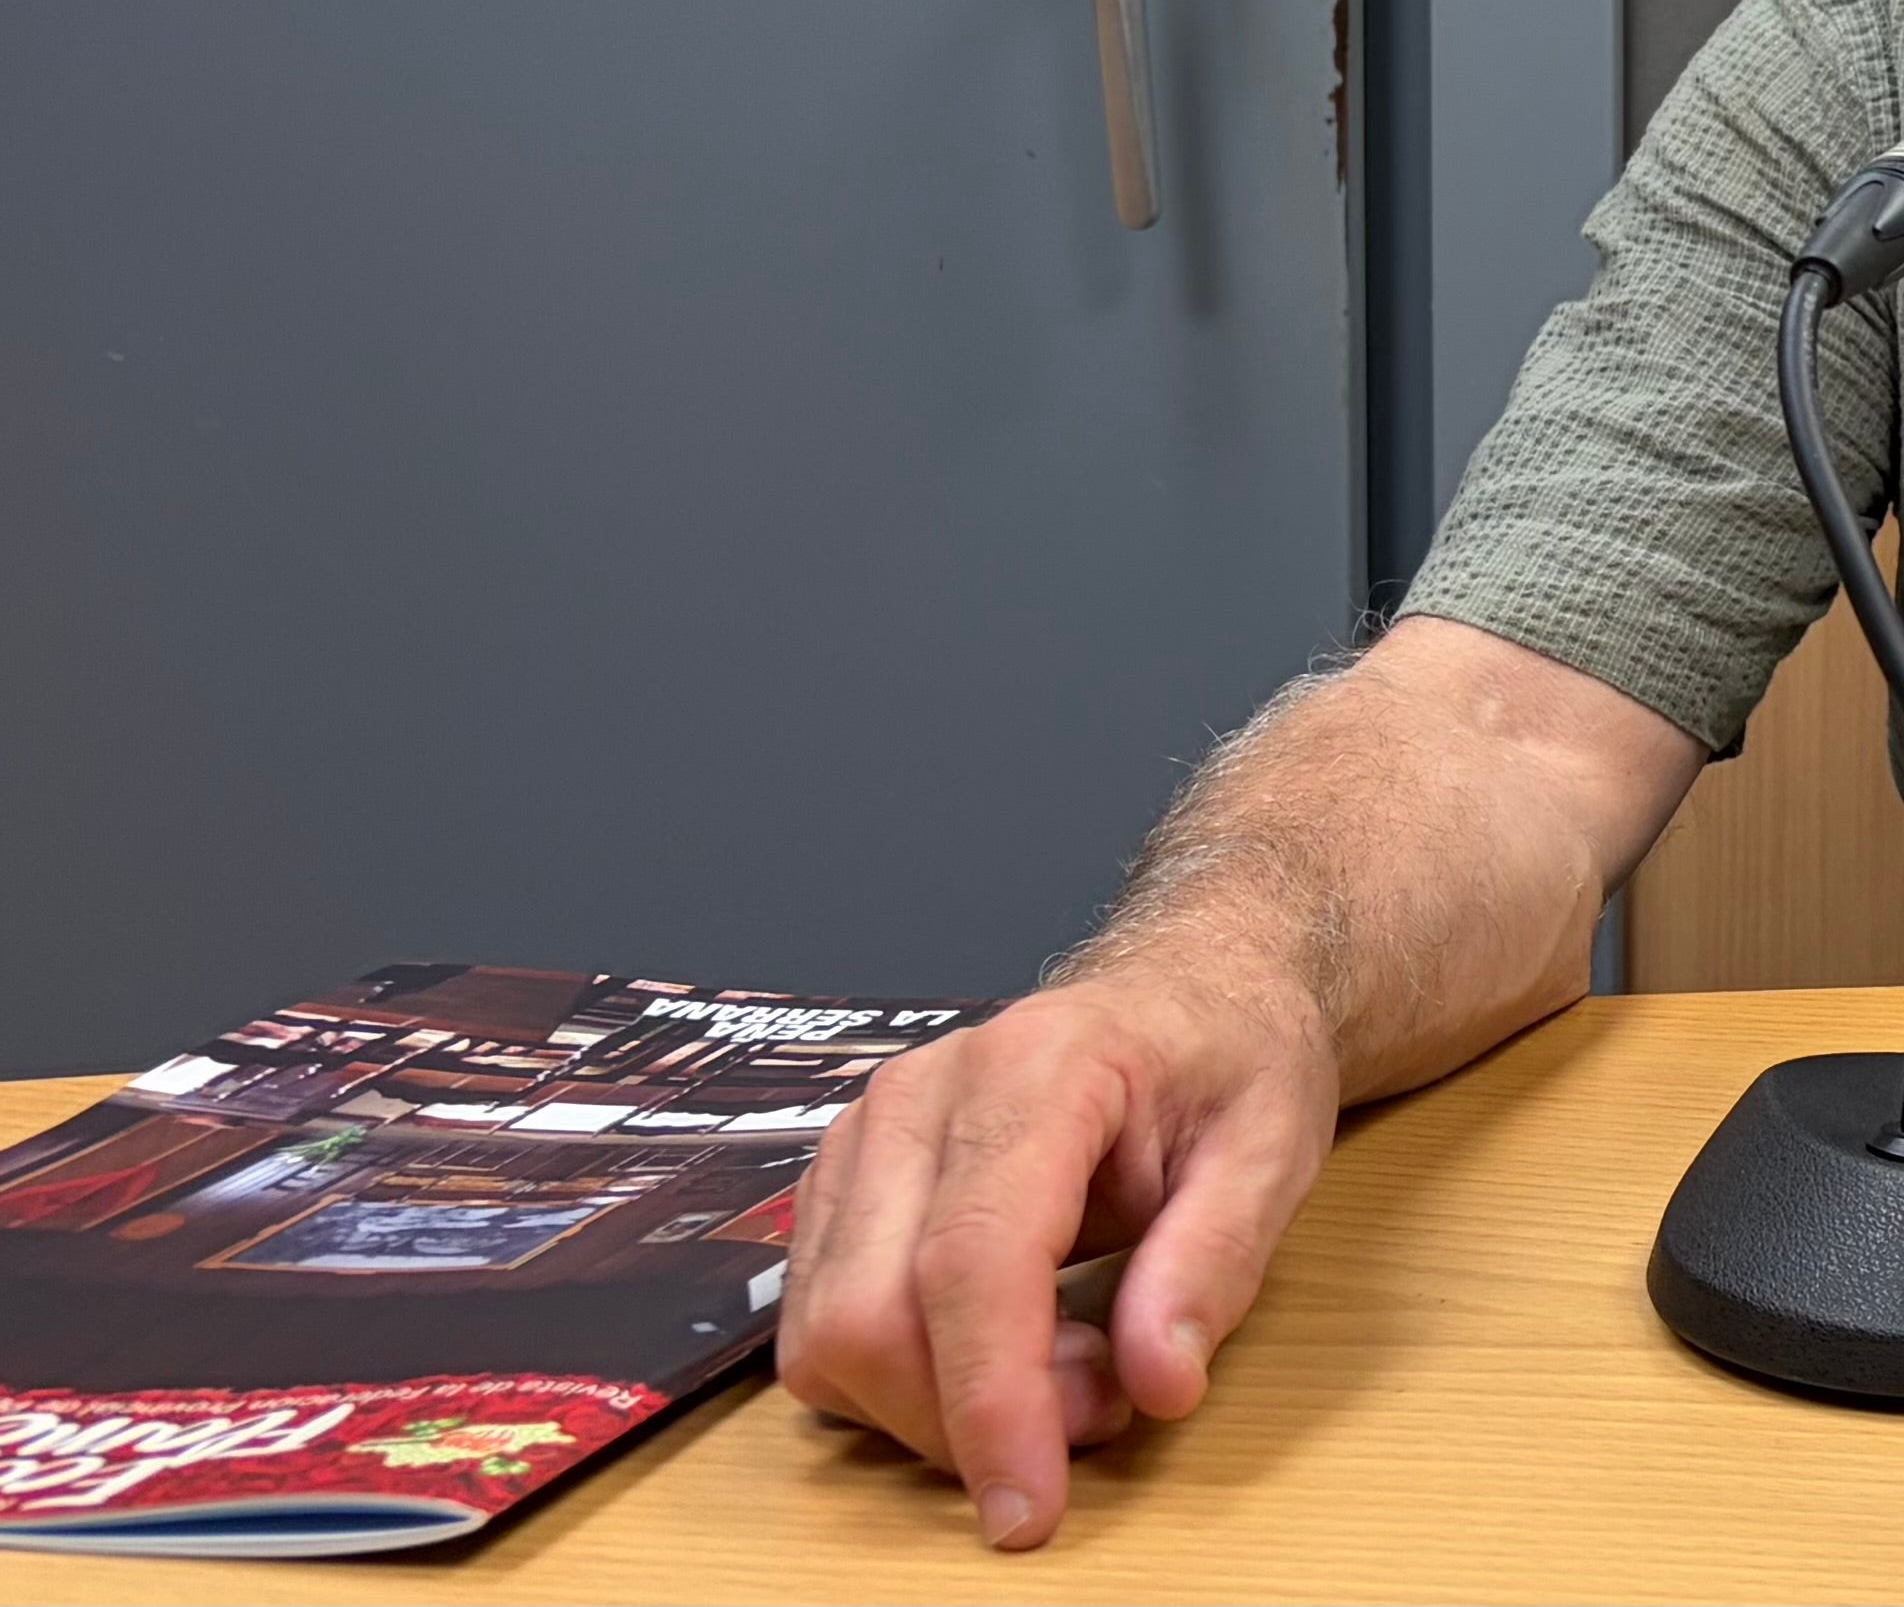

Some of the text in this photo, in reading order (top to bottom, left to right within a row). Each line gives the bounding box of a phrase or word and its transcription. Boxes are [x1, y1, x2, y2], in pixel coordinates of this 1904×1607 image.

[641, 997, 961, 1027] LA SERRANA
[702, 1020, 847, 1045] PEÑA
[479, 1380, 515, 1396] de
[515, 1380, 644, 1410] Revista
